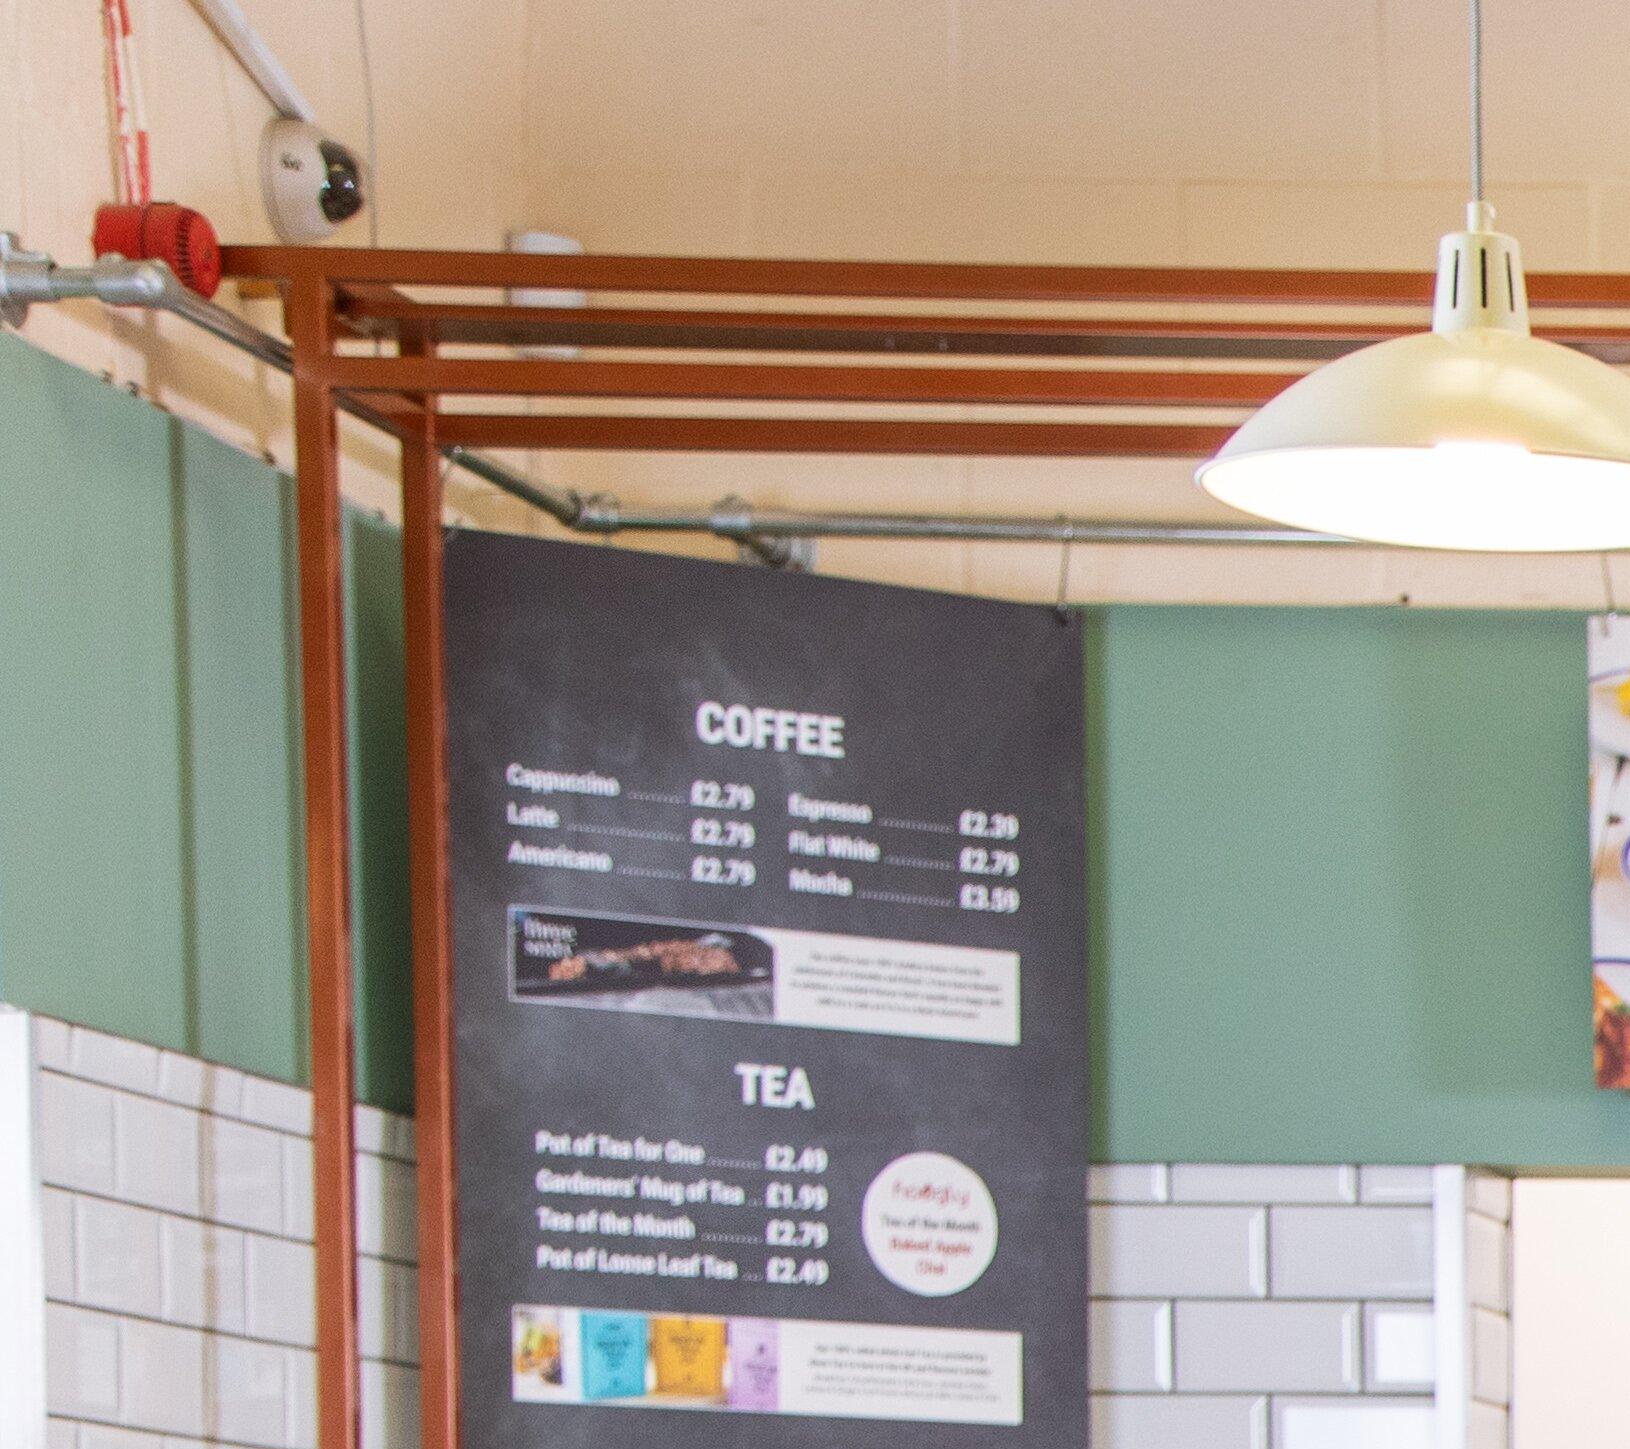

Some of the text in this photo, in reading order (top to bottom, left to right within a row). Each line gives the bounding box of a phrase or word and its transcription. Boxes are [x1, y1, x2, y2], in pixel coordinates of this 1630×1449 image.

[697, 701, 845, 758] COFFEE
[506, 763, 755, 811] Cappuccino £2.79
[788, 792, 873, 824] Espresso
[507, 801, 755, 849] Latte £2.79
[508, 840, 756, 887] Americano £2.79
[788, 830, 1020, 878] Flat White £2.79
[789, 868, 853, 897] Mocha
[734, 1062, 815, 1110] TEA
[535, 1130, 828, 1174] Pot of Tea for One £2.49
[640, 1175, 685, 1207] Mug
[685, 1178, 709, 1204] of
[710, 1179, 745, 1206] Tea
[536, 1206, 829, 1249] Tea of the Month £2.79
[536, 1244, 829, 1286] Pot of Loose Leaf Tea £2.49
